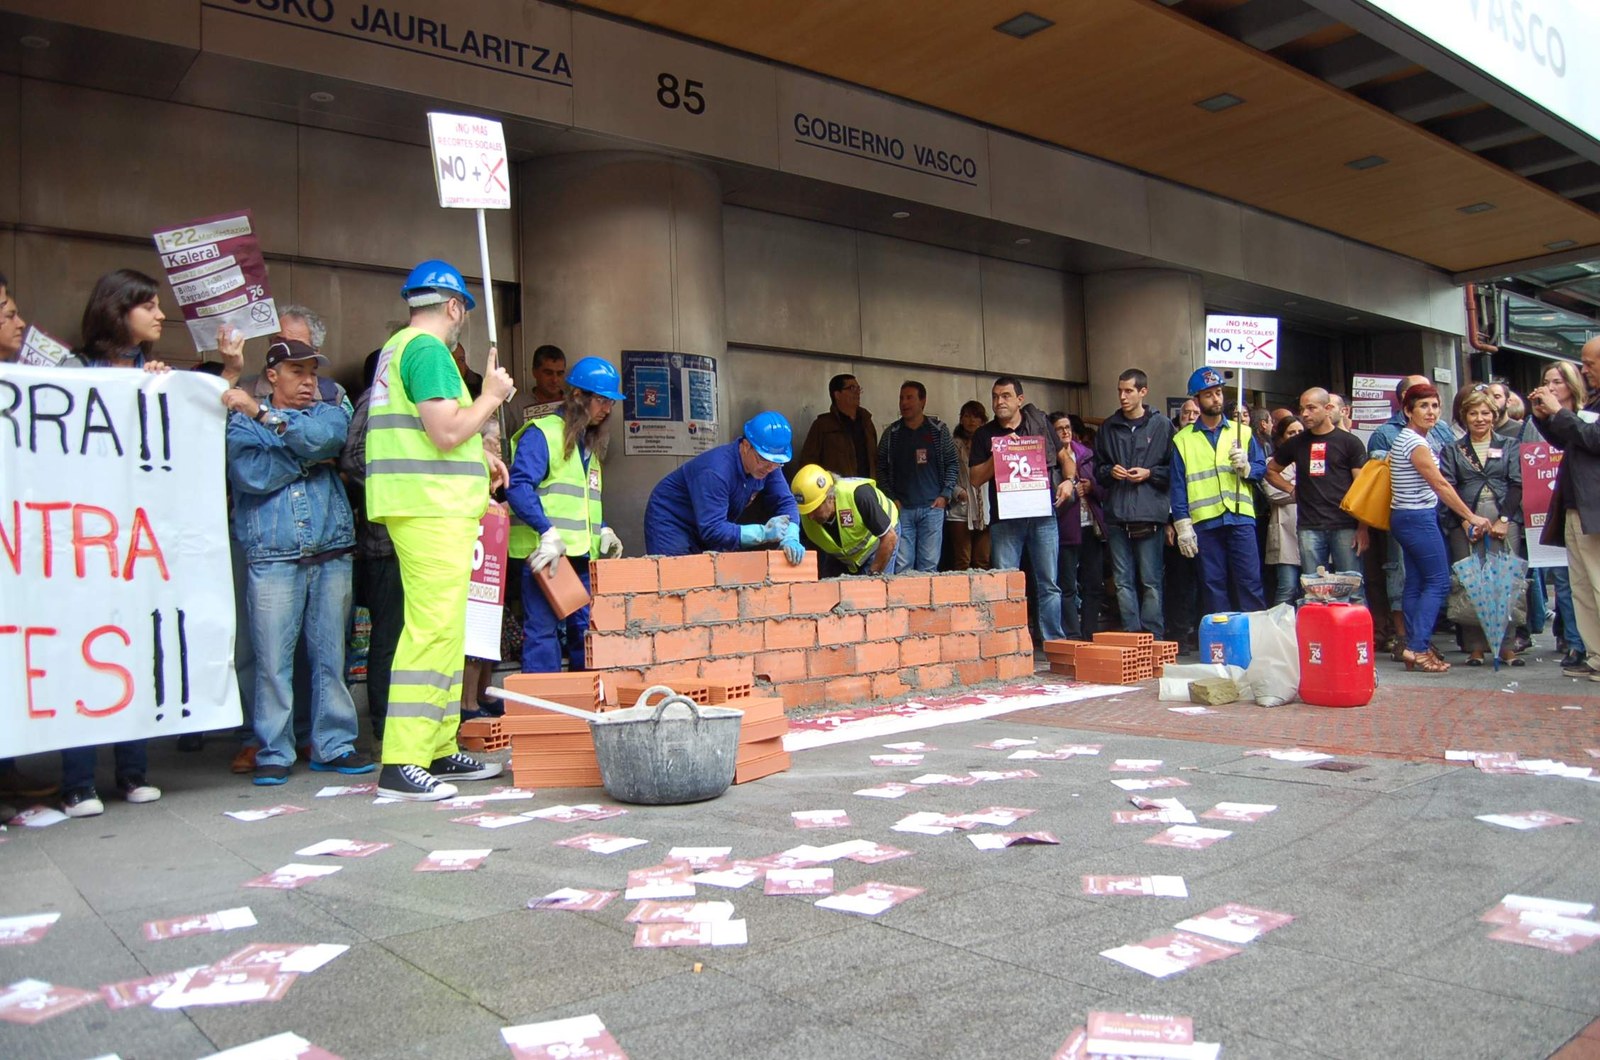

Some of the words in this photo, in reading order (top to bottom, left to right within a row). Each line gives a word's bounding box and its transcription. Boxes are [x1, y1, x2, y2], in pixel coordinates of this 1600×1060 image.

[232, 0, 334, 22] KO
[351, 8, 573, 79] JAURLARITZA
[656, 72, 705, 115] 85
[793, 113, 904, 161] GOBIERNO
[913, 144, 977, 178] VASCO
[440, 155, 466, 181] NO
[168, 245, 218, 266] Kalera!
[250, 285, 264, 301] 26
[1207, 337, 1232, 352] NO
[1009, 456, 1032, 482] 26
